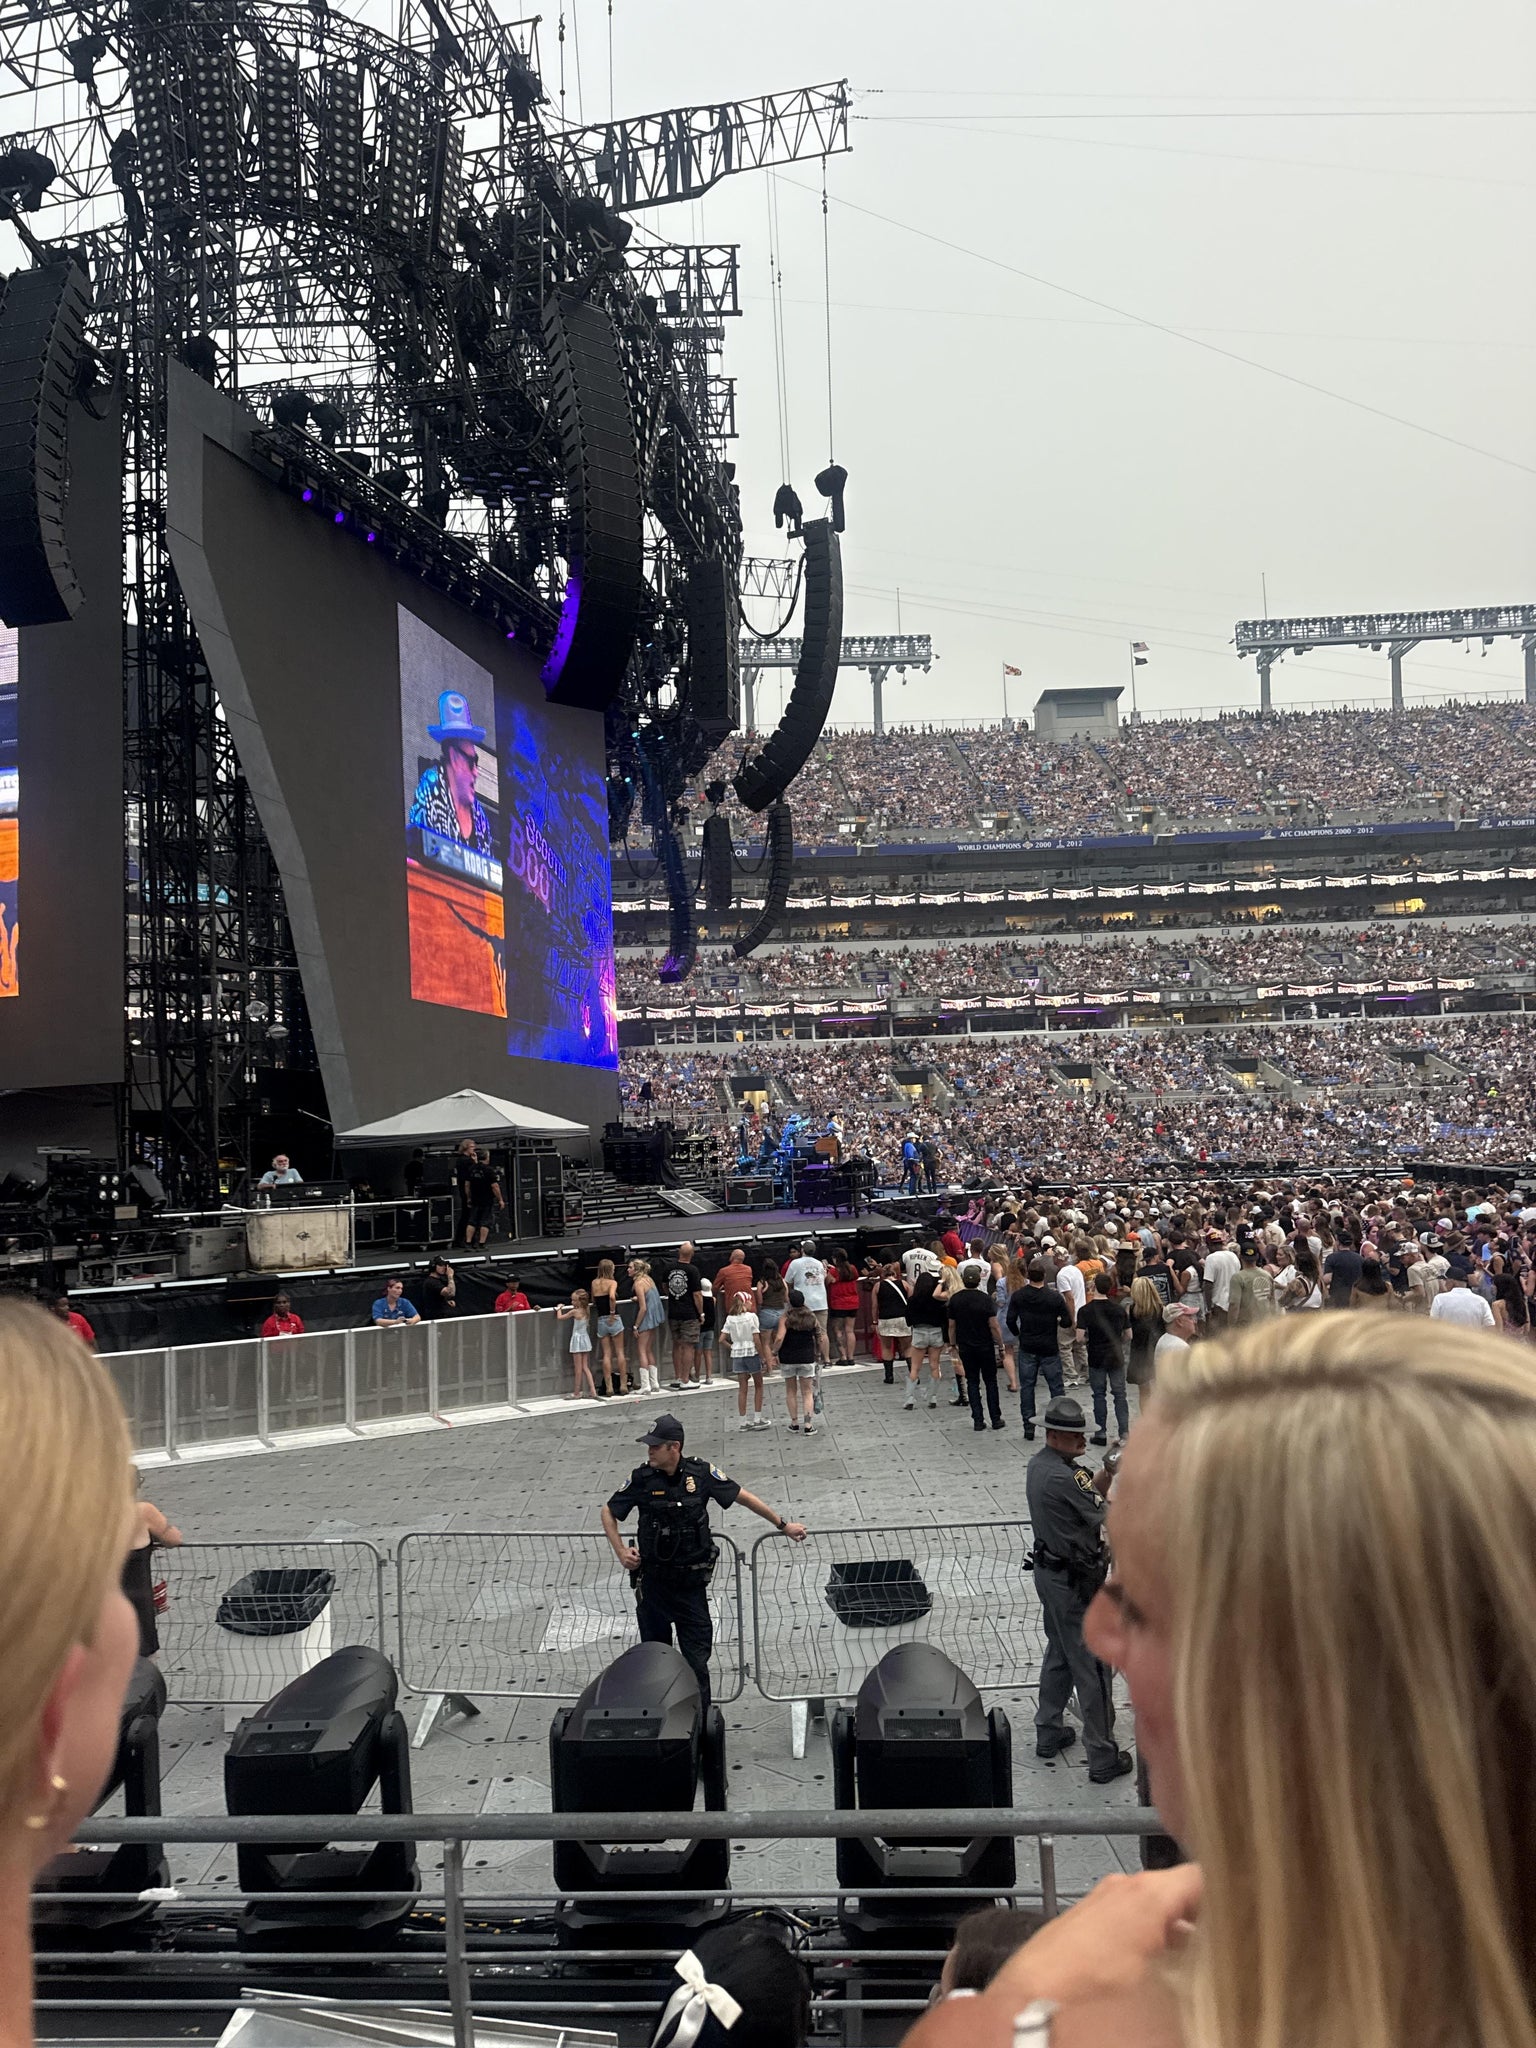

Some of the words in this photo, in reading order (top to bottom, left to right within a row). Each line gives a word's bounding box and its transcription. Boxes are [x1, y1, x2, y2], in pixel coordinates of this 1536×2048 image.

[1511, 818, 1535, 826] NORTH
[1294, 828, 1333, 836] CHAMPIONS
[1035, 841, 1052, 849] 2000
[463, 848, 489, 880] KORG
